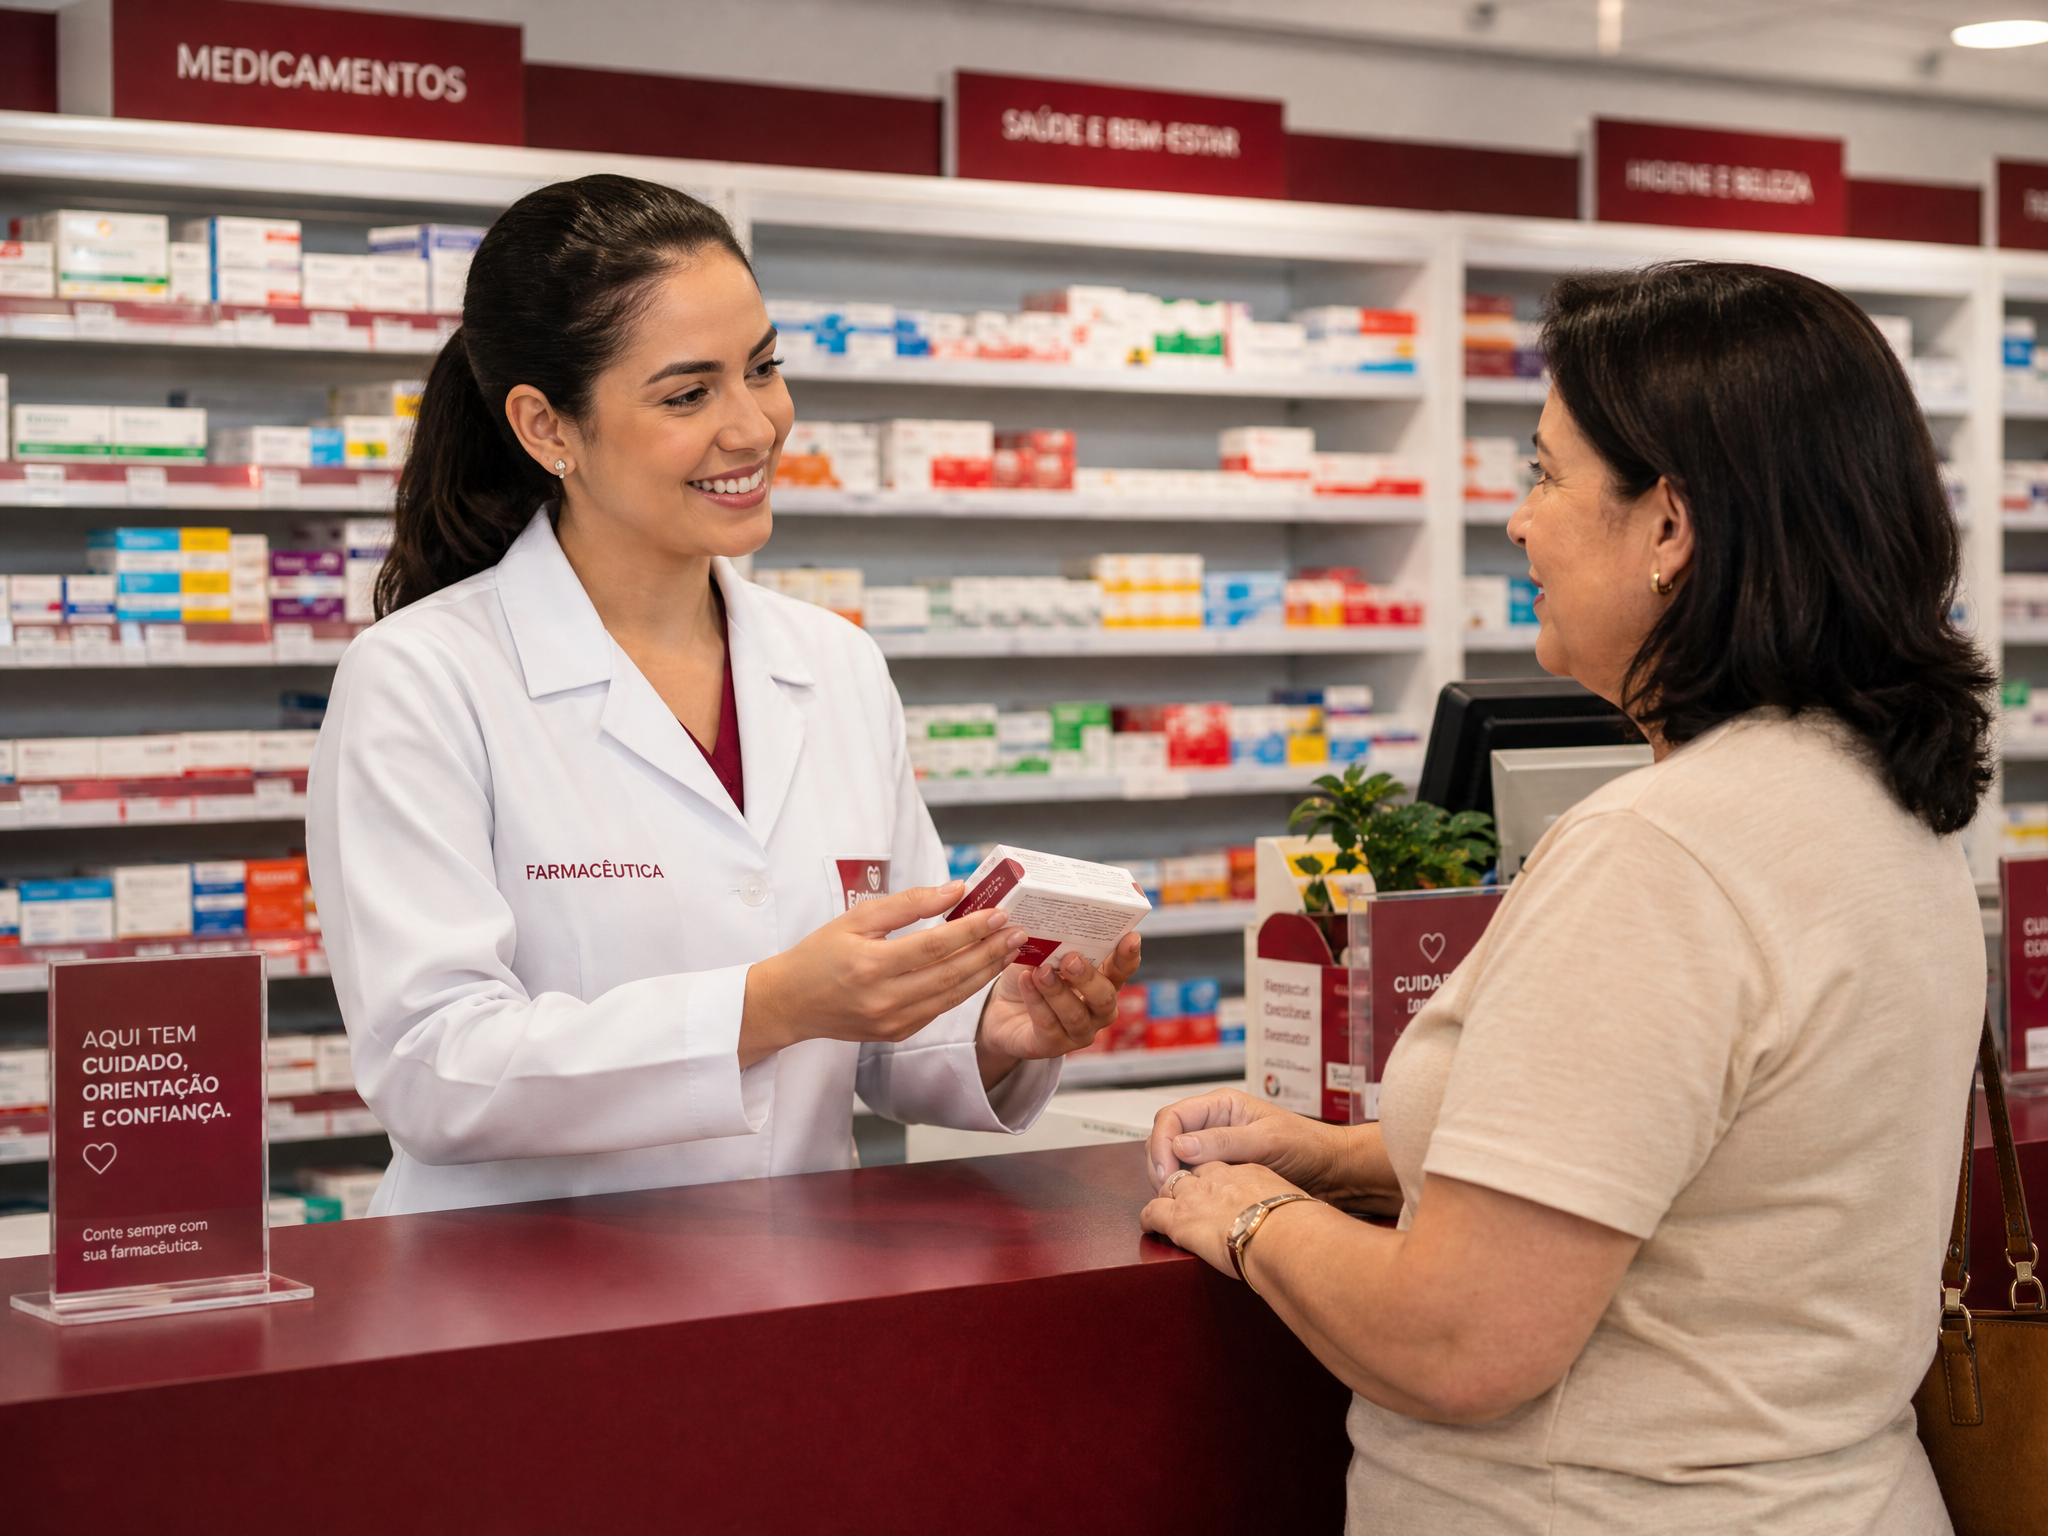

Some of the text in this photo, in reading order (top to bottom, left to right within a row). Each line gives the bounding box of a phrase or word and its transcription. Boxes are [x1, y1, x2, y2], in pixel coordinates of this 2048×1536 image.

[177, 42, 467, 103] MEDICAMENTOS
[1001, 104, 1086, 146] SAÚDE
[1086, 115, 1106, 148] E
[526, 859, 665, 880] FARMACÊUTICA
[82, 1025, 196, 1050] AQUI TEM
[82, 1052, 189, 1075] CUIDADO,
[82, 1073, 219, 1101] ORIENTAÇÃO
[83, 1102, 231, 1128] E CONFIANÇA.
[82, 1220, 208, 1242] Conte sempre com
[82, 1249, 108, 1262] sua
